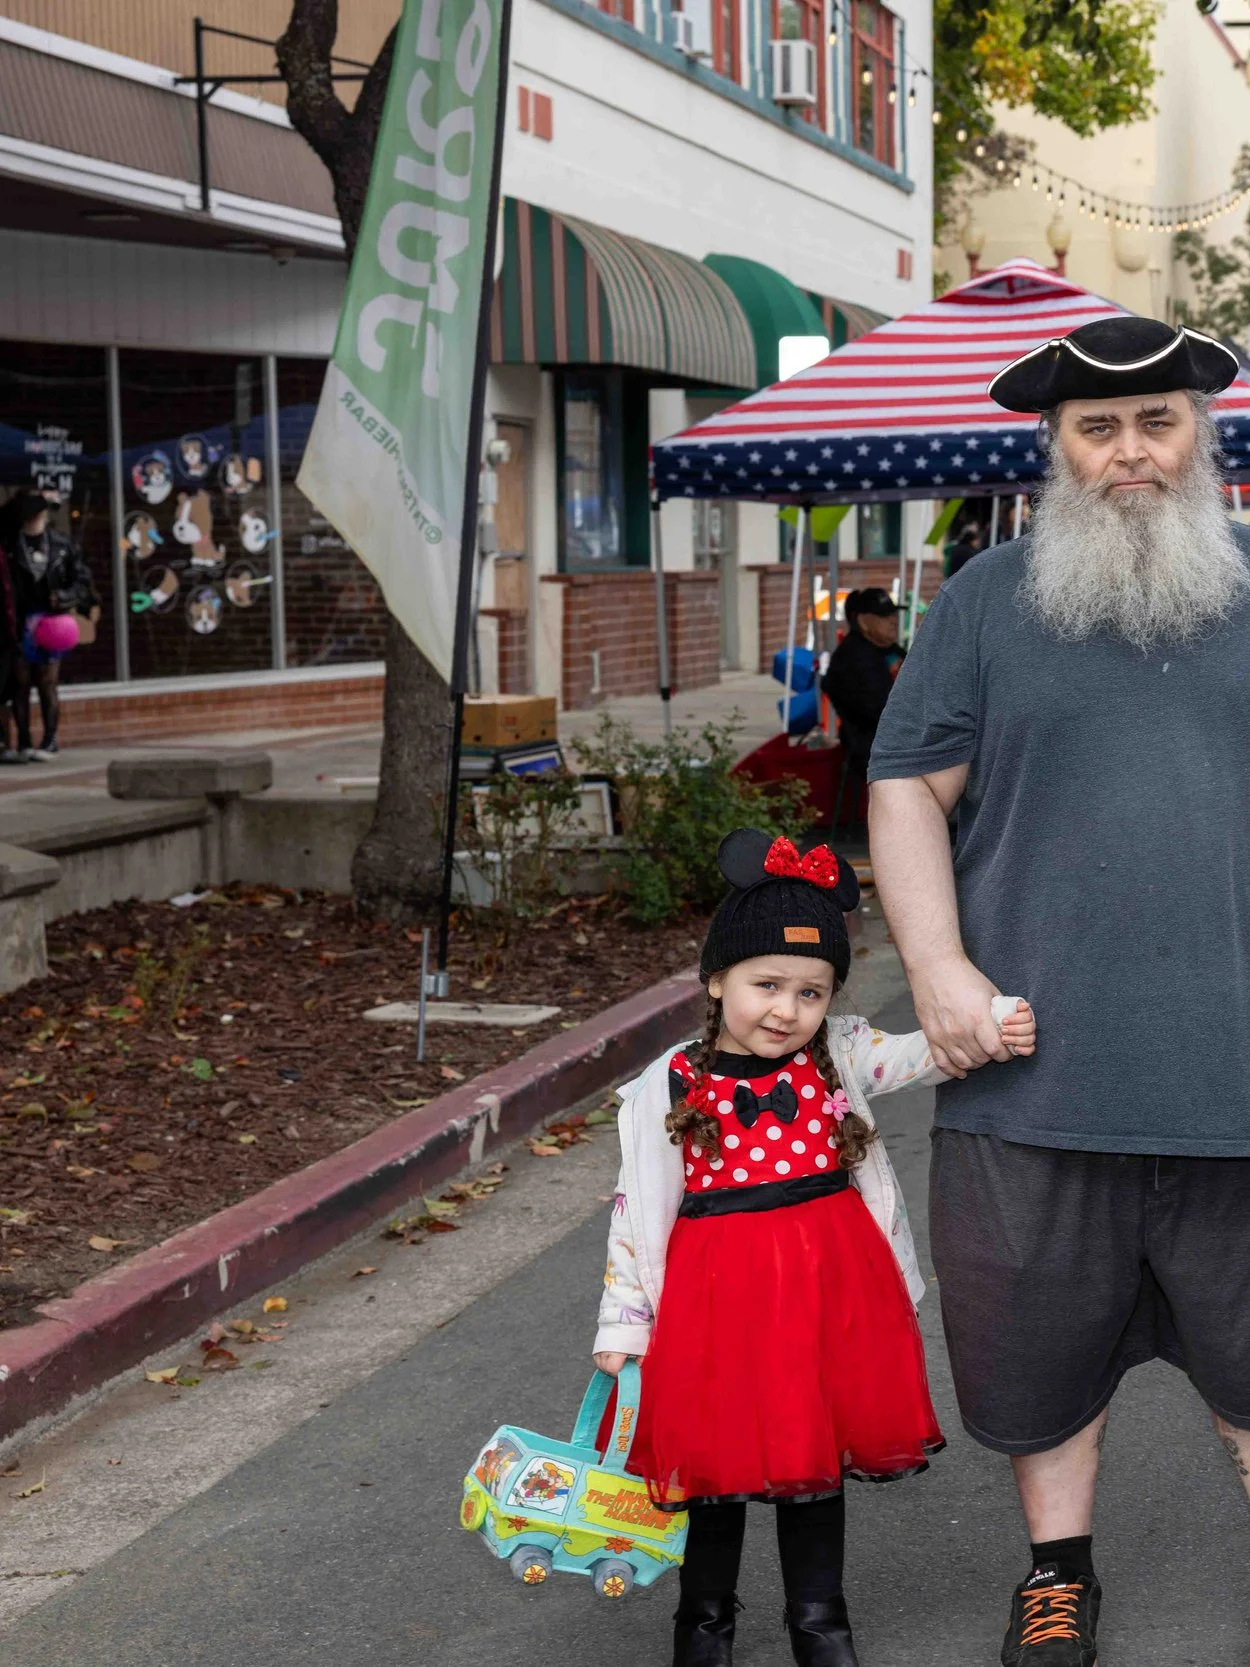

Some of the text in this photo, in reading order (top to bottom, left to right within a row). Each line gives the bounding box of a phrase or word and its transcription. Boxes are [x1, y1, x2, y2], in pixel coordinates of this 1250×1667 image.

[585, 1489, 617, 1508] THE
[603, 1508, 673, 1531] MACHINE
[1026, 1570, 1056, 1588] AIRWALK
